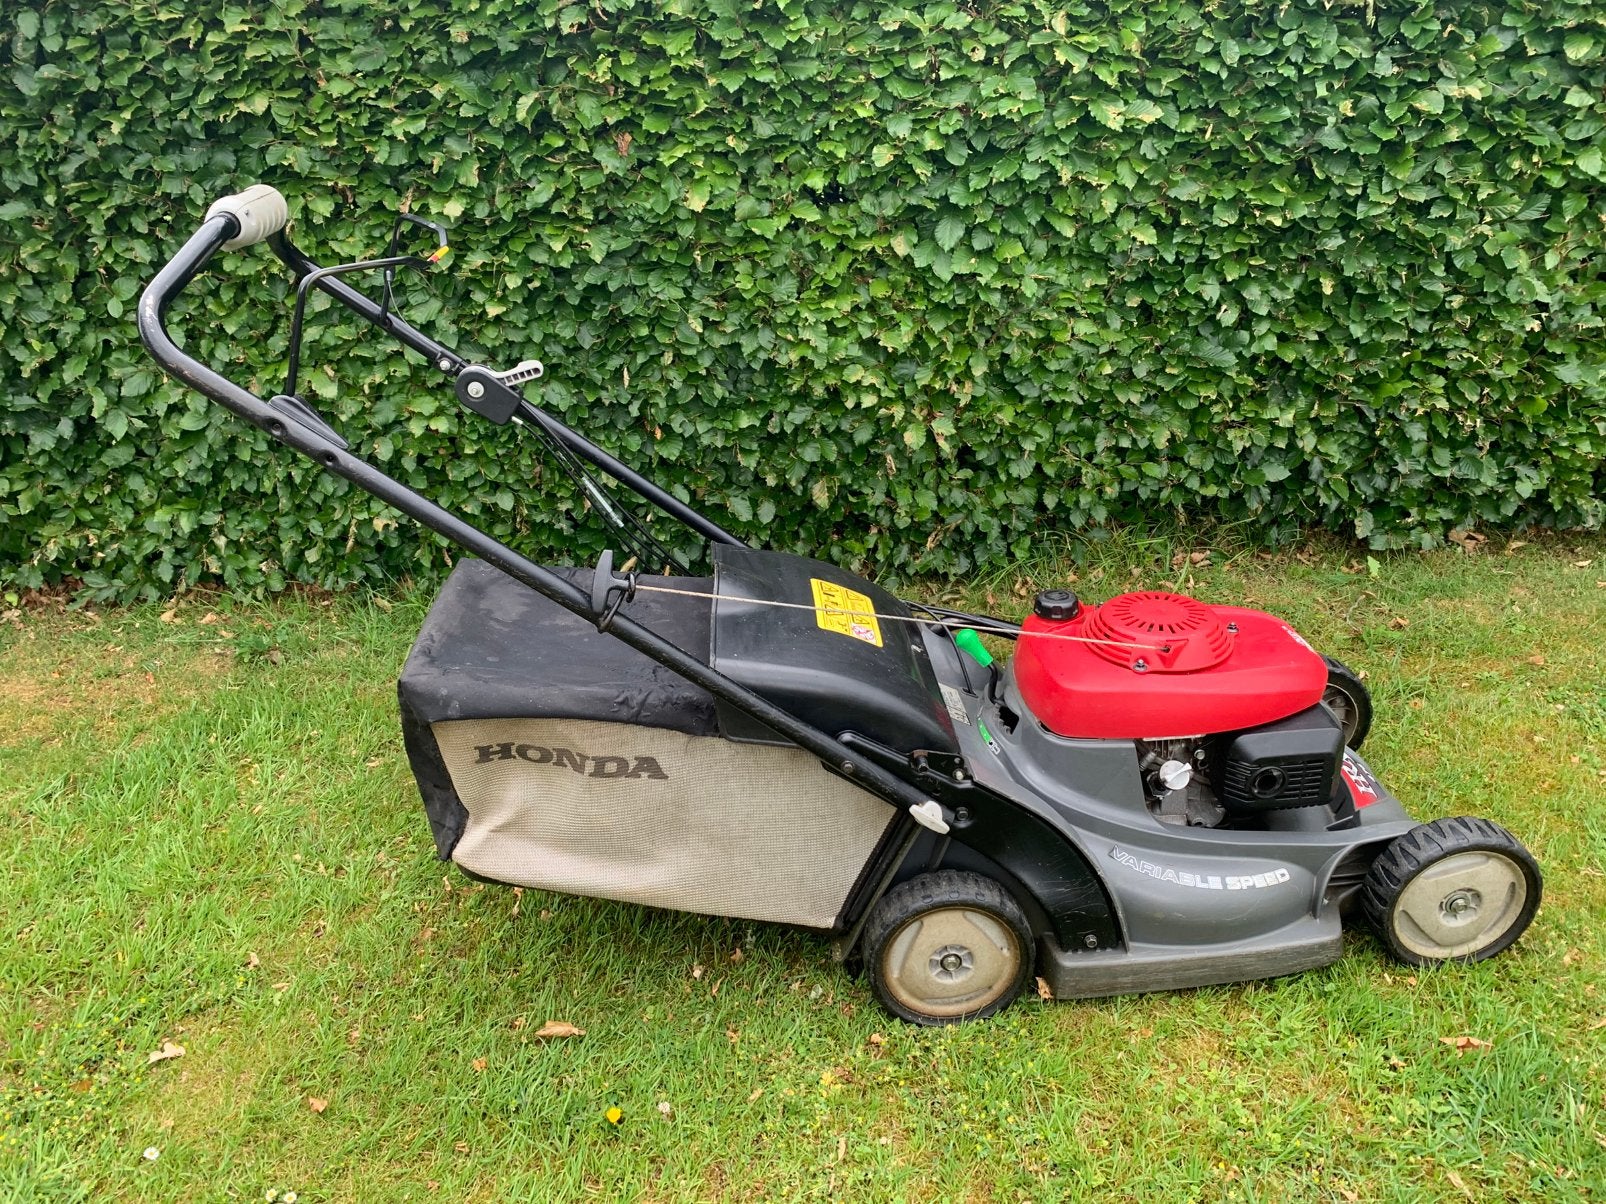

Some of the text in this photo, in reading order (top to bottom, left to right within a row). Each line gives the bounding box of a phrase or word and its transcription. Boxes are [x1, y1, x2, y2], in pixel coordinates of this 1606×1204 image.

[474, 742, 669, 780] HONDA
[1110, 845, 1291, 890] VARIABLE SPEED
